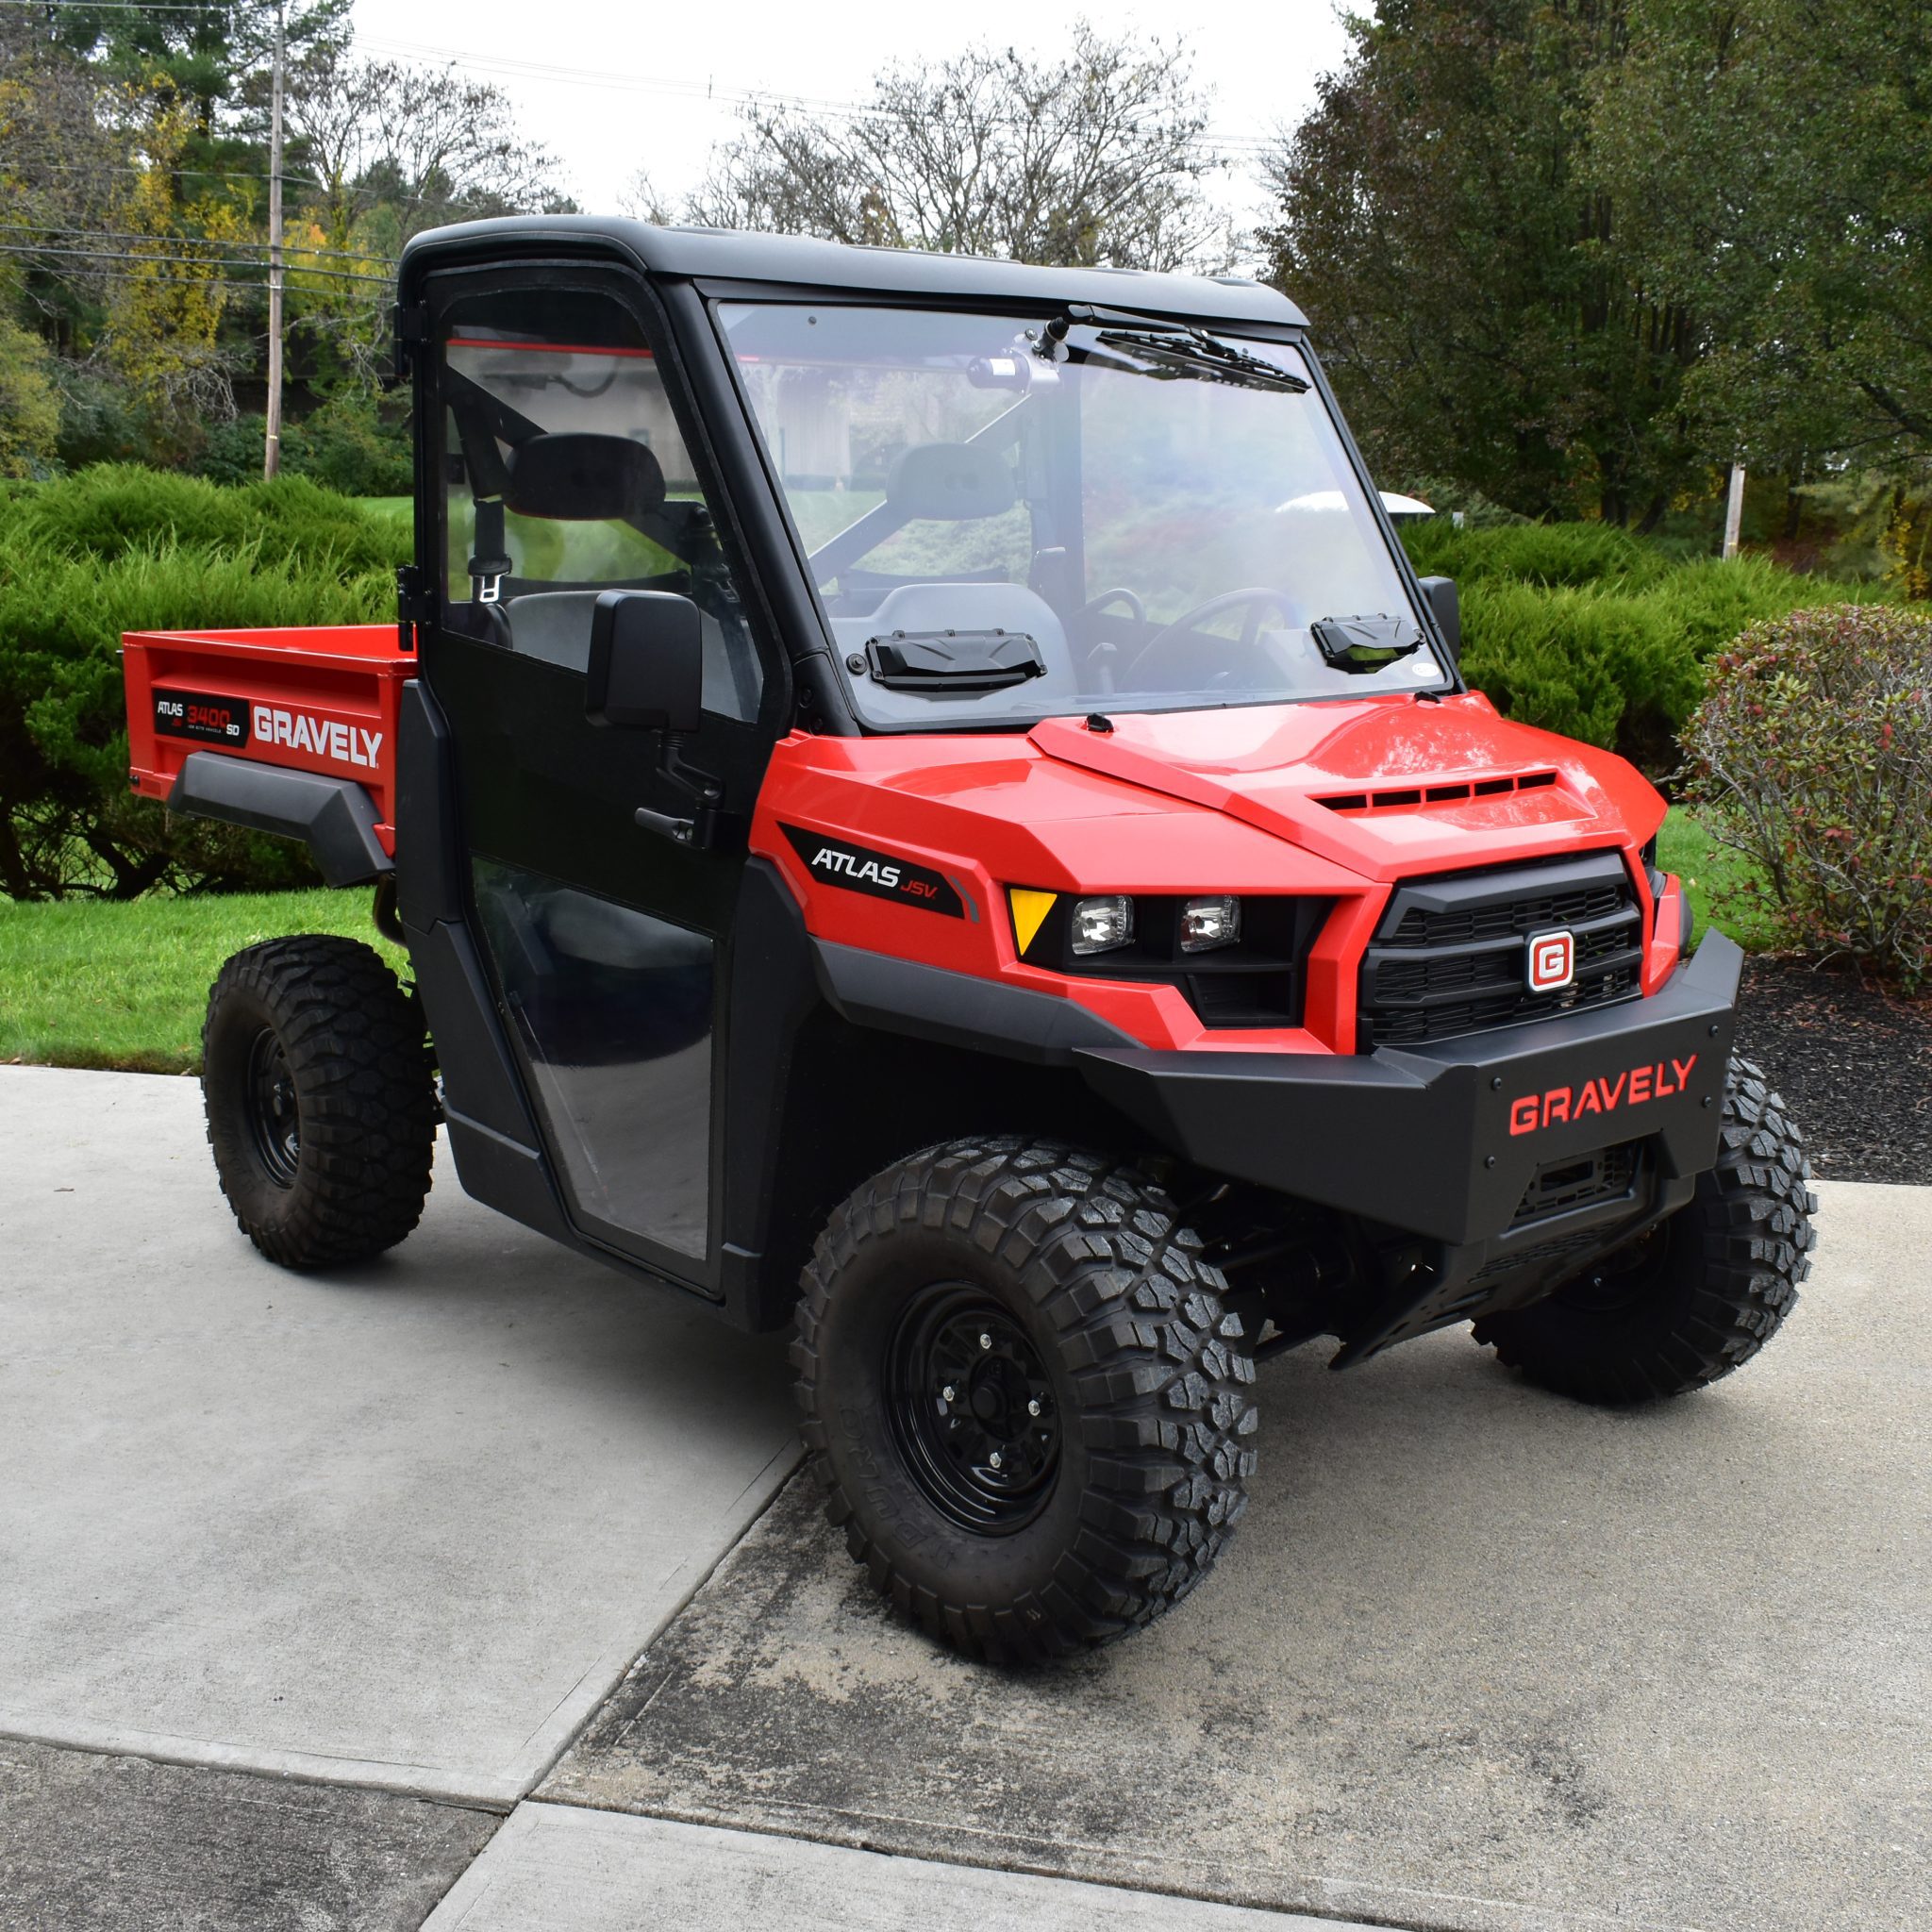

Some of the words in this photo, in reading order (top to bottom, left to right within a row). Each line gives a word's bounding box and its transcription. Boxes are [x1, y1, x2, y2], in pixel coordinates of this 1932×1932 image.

[158, 701, 183, 717] ATLAS
[187, 705, 230, 729] 3400
[225, 724, 240, 737] SD
[253, 706, 383, 769] GRAVELY
[811, 848, 901, 888] ATLAS
[900, 880, 939, 899] JSV
[1509, 1052, 1699, 1137] GRAVELY
